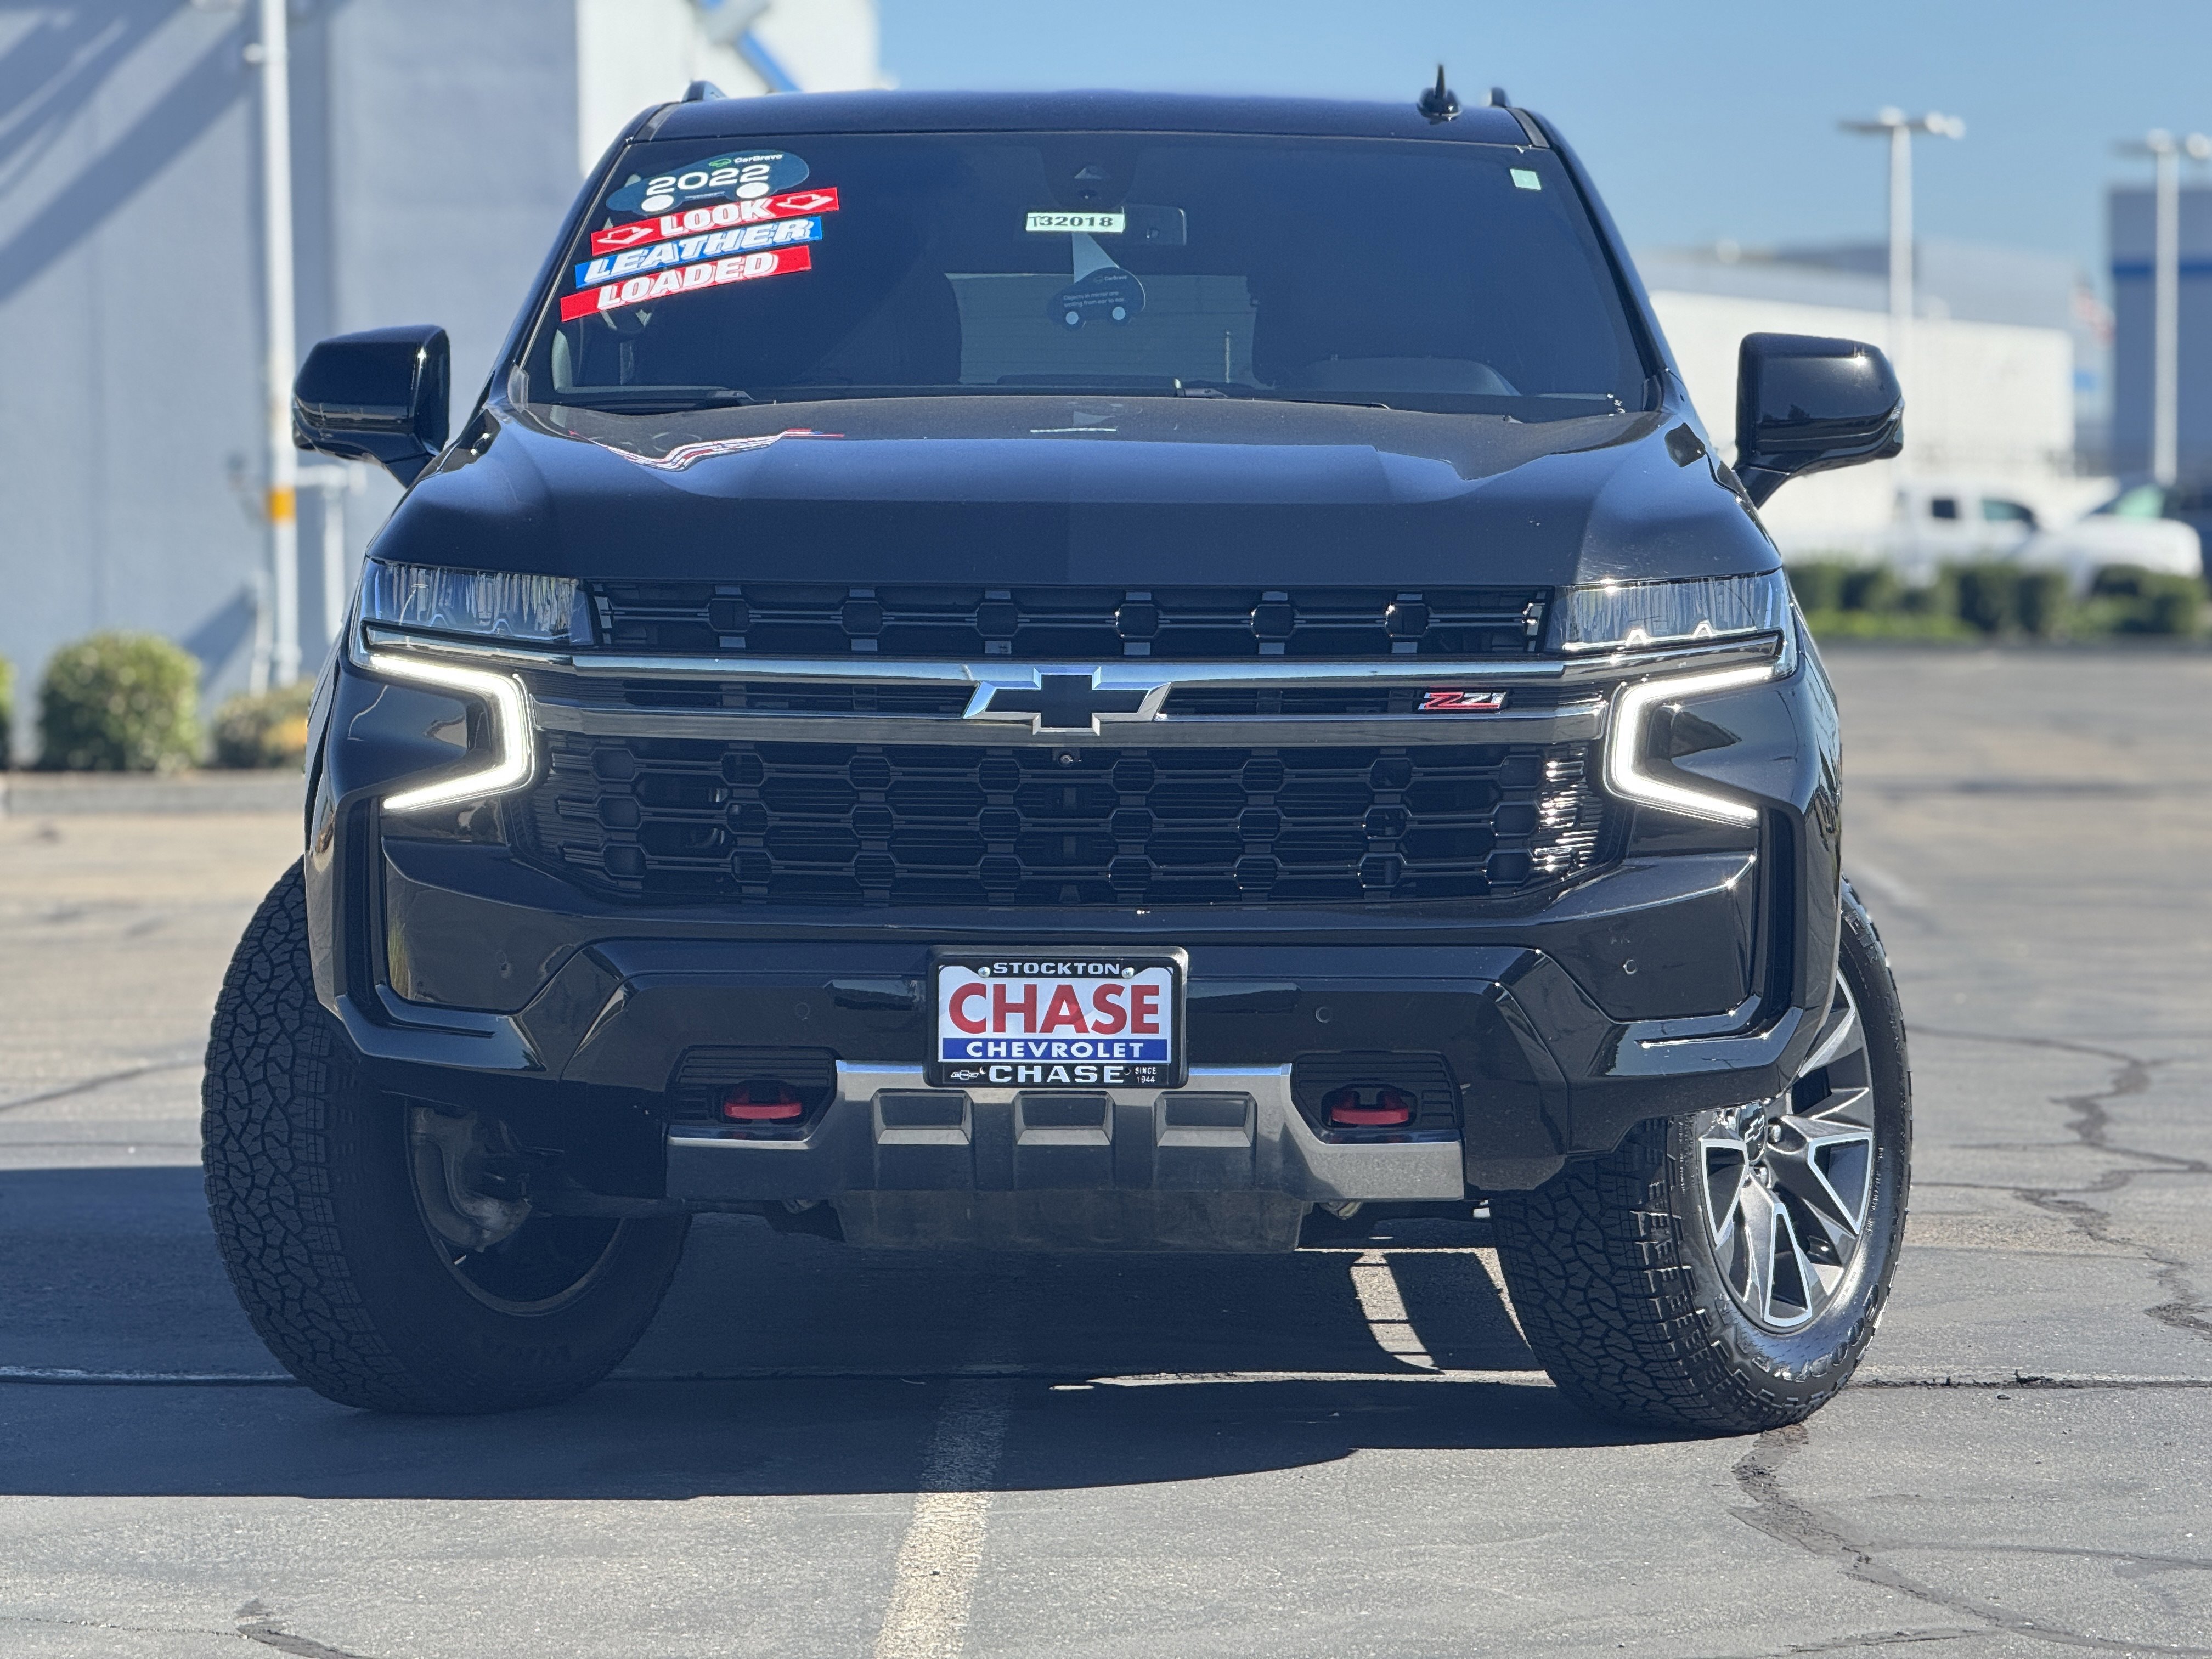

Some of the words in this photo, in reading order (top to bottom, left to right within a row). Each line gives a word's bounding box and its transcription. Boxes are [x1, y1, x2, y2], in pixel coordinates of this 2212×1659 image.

[646, 164, 770, 196] 2022
[659, 197, 776, 238] LOOK
[584, 218, 815, 284] LEATHER
[597, 252, 779, 311] LOADED
[1418, 692, 1506, 710] Z71
[992, 962, 1120, 975] STOCKTON
[949, 982, 1160, 1035] CHASE
[966, 1041, 1144, 1058] CHEVROLET
[989, 1065, 1125, 1084] CHASE
[1135, 1066, 1156, 1075] SINCE
